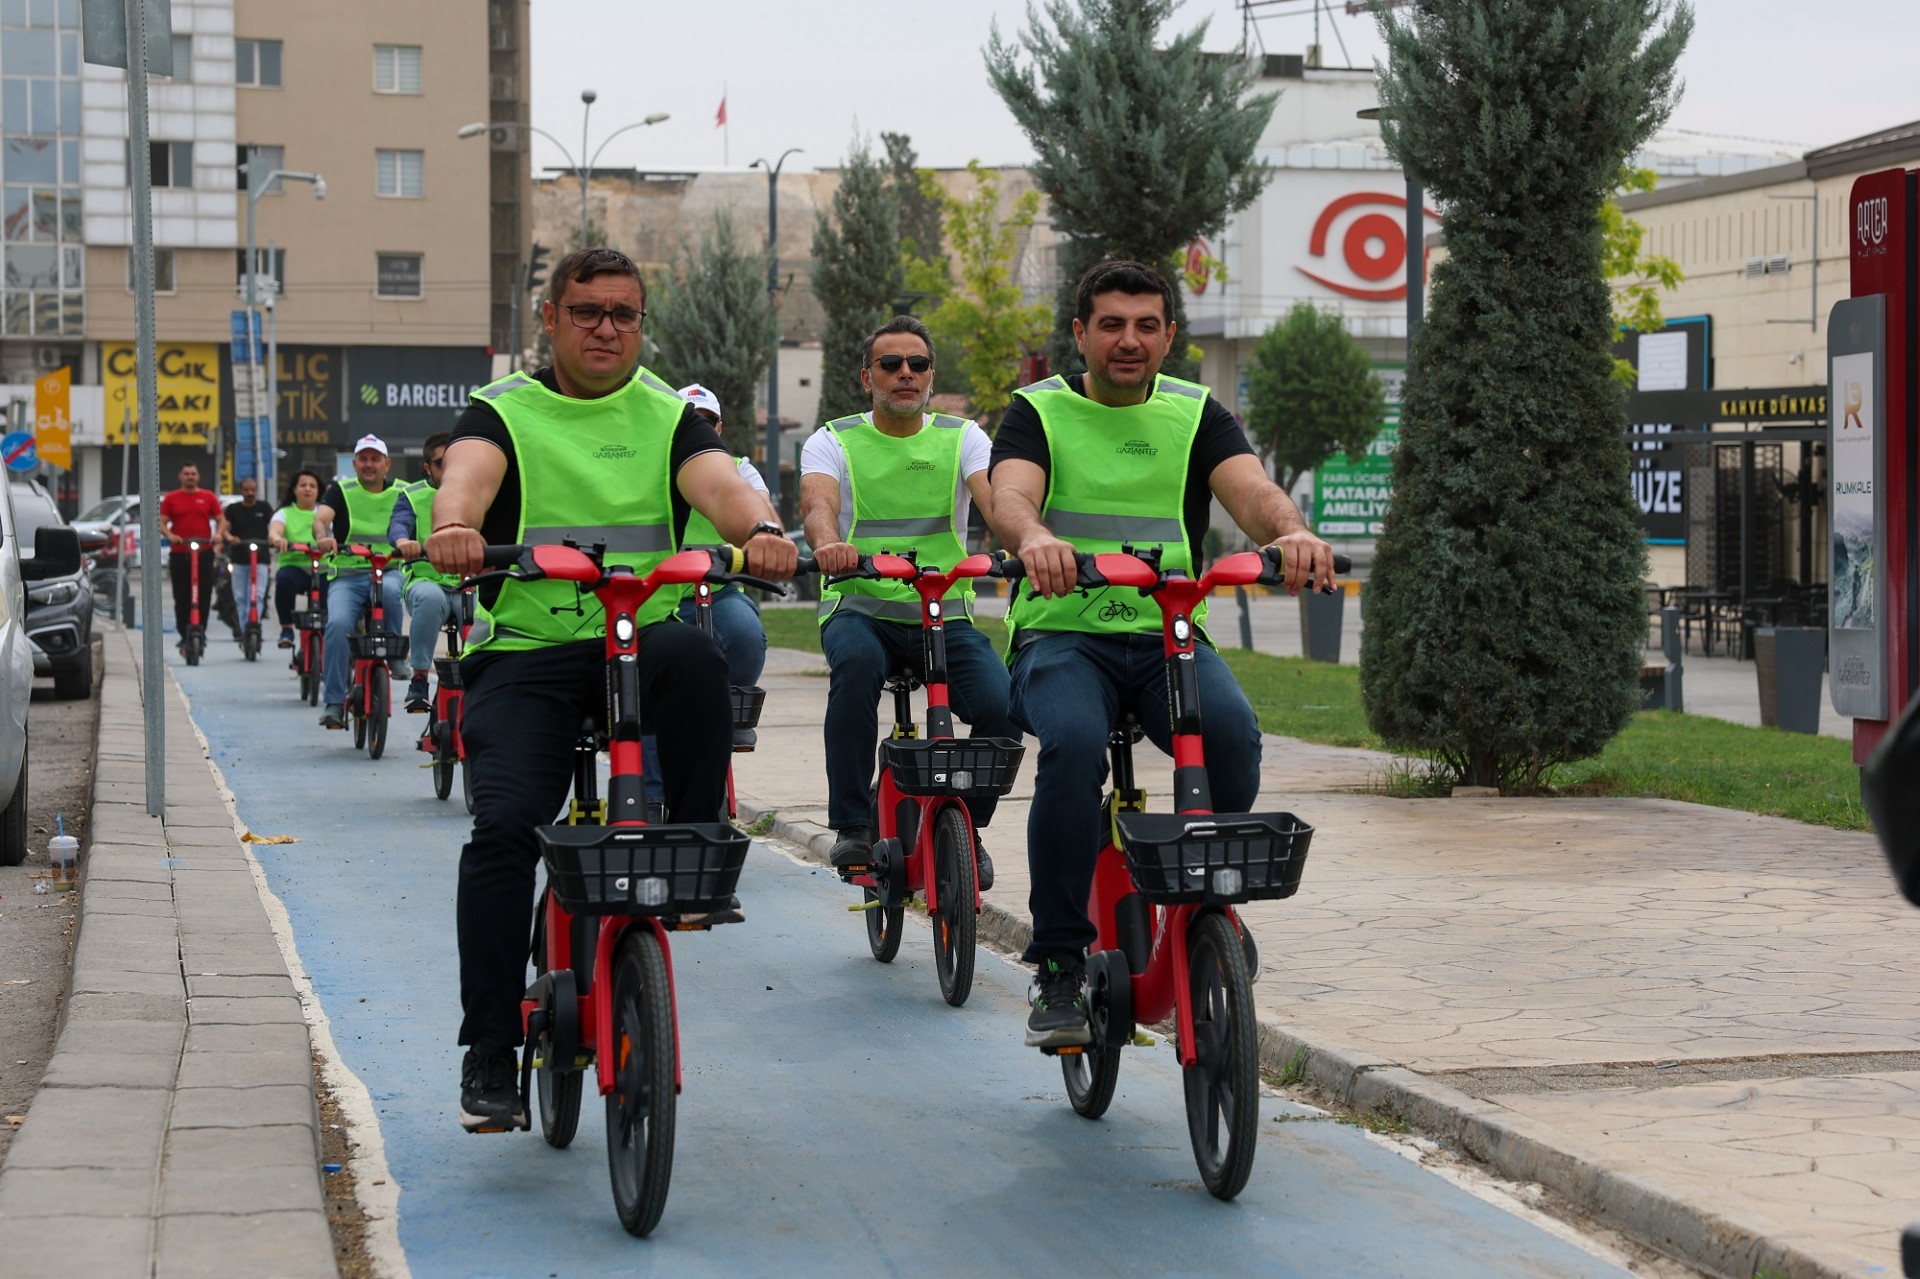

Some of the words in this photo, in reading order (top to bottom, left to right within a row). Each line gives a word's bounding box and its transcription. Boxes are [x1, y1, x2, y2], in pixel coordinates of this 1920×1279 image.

[264, 352, 329, 388] LIÇ
[157, 395, 211, 411] AKI
[276, 384, 328, 420] TİK
[1721, 400, 1765, 416] KAHVE
[1770, 395, 1826, 415] DÜNYAS
[1322, 486, 1394, 500] KATARA
[1322, 500, 1390, 517] AMELİY
